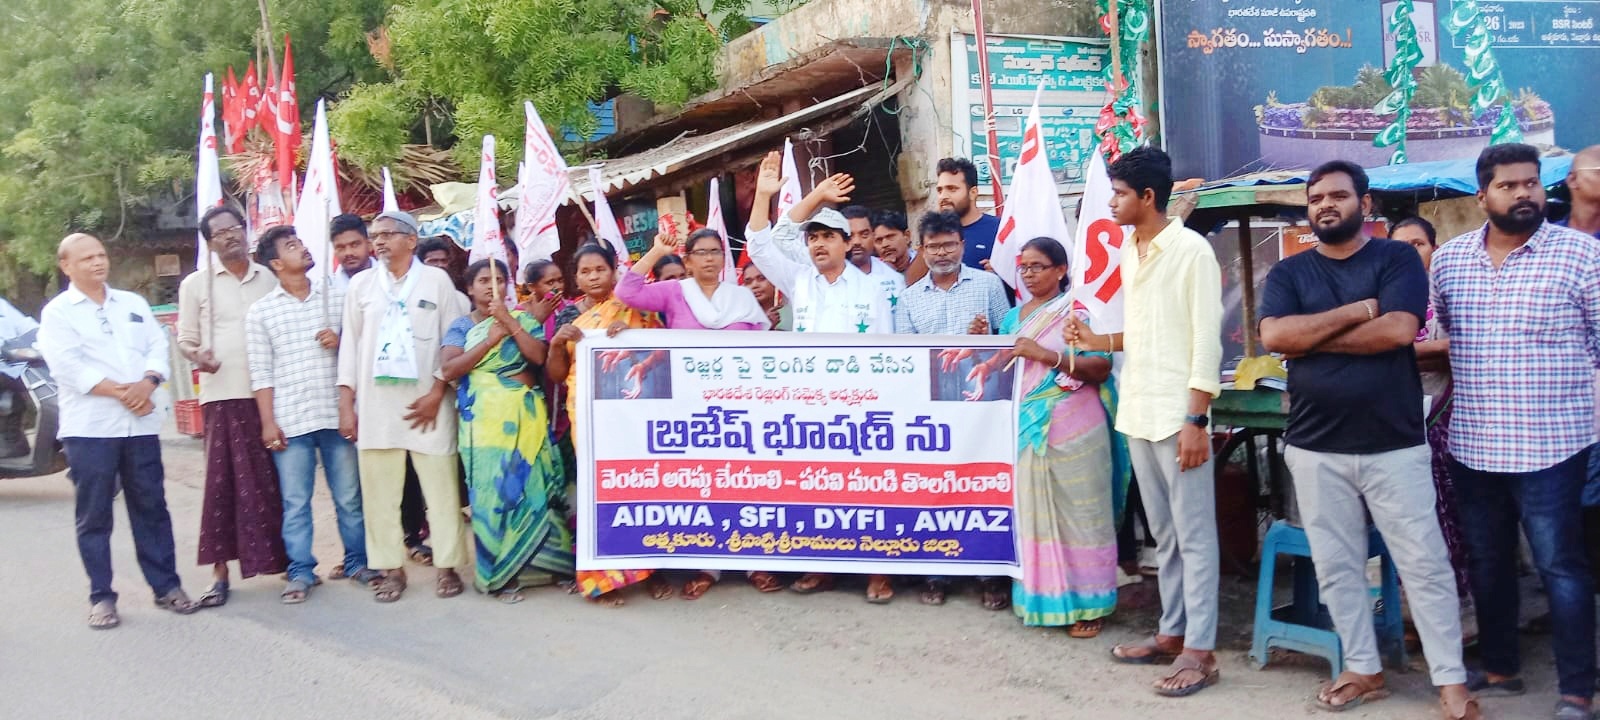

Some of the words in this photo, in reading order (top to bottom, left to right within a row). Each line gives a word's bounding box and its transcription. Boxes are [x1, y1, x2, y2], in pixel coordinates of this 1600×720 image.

[1483, 15, 1500, 31] 26
[1552, 19, 1571, 29] BSR
[732, 356, 752, 379] పై
[762, 356, 817, 379] లైంగిక
[826, 355, 860, 374] దాడి
[870, 353, 915, 374] చేసిన
[647, 405, 756, 454] బ్రిజేష్
[763, 411, 894, 456] భూషణ్
[905, 415, 951, 452] ను
[600, 461, 660, 490] వెంటనే
[662, 464, 713, 498] అరెస్టు
[715, 462, 782, 490] చేయాలి
[799, 465, 844, 491] పదవి
[847, 467, 898, 492] నుండి
[902, 470, 1012, 494] తొలగించాలి
[611, 505, 714, 528] AIDWA
[738, 506, 787, 529] SFI
[814, 508, 885, 531] DYFI
[913, 510, 1010, 533] AWAZ
